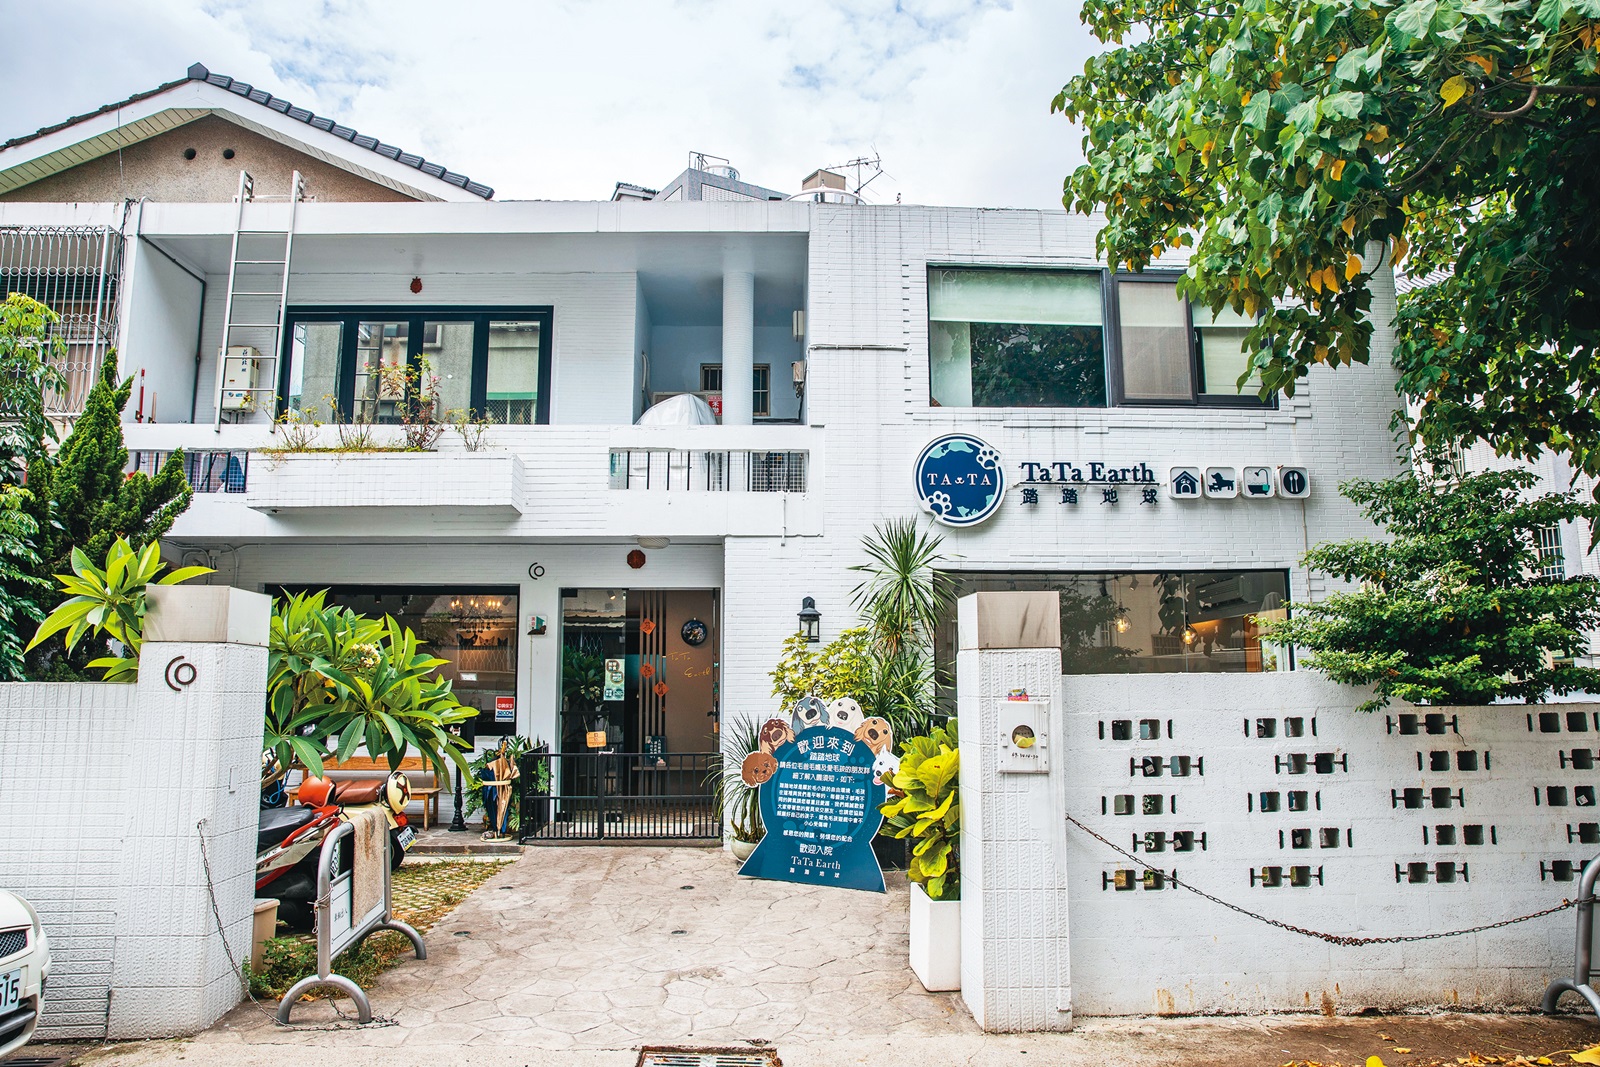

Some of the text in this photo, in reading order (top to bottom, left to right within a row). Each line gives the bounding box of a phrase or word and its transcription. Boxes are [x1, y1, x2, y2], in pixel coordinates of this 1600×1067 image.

[1021, 462, 1155, 484] TaTa Earth
[797, 736, 856, 757] 歡迎來到
[809, 752, 840, 763] 踏踏地球
[791, 855, 841, 870] TaTa Earth
